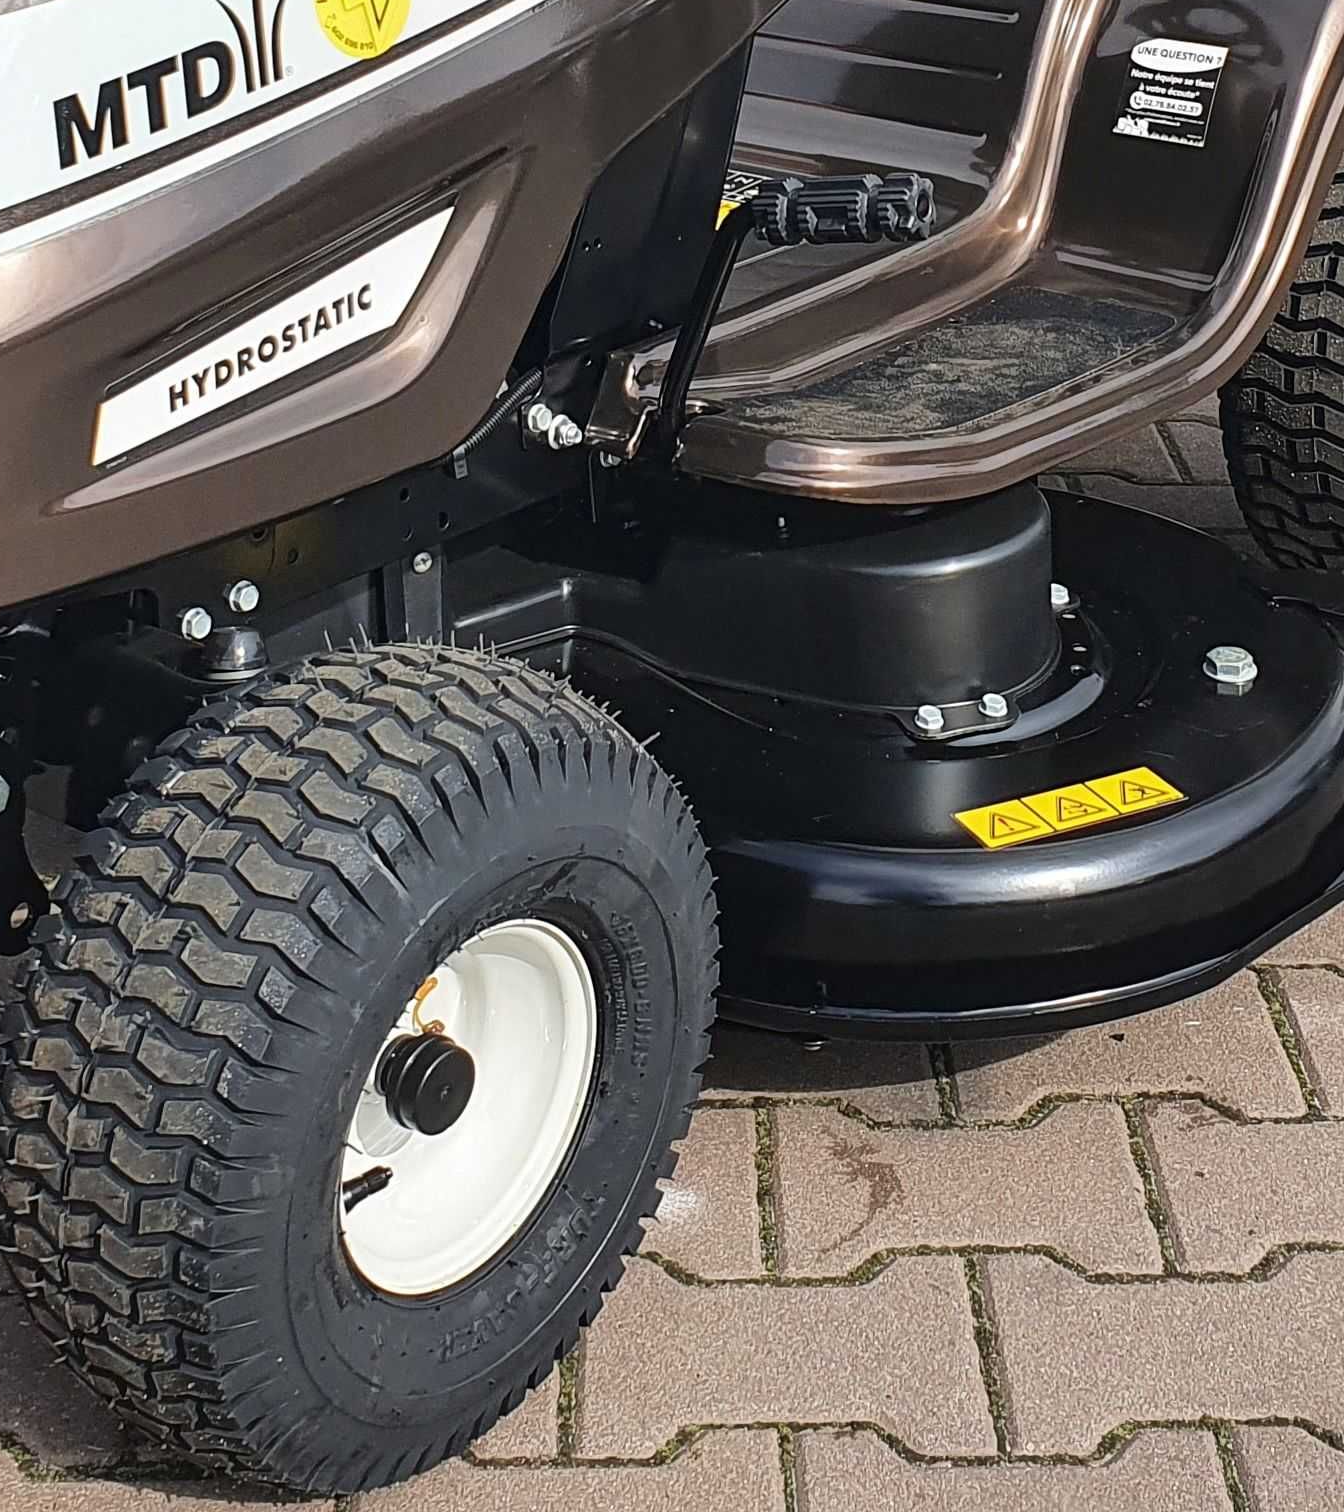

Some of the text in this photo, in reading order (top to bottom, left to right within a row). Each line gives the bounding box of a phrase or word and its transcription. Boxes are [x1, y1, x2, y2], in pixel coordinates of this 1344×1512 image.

[53, 40, 236, 170] MTD
[1137, 46, 1159, 56] UNE
[1160, 48, 1215, 64] QUESTION
[169, 283, 372, 413] HYDROSTATIC
